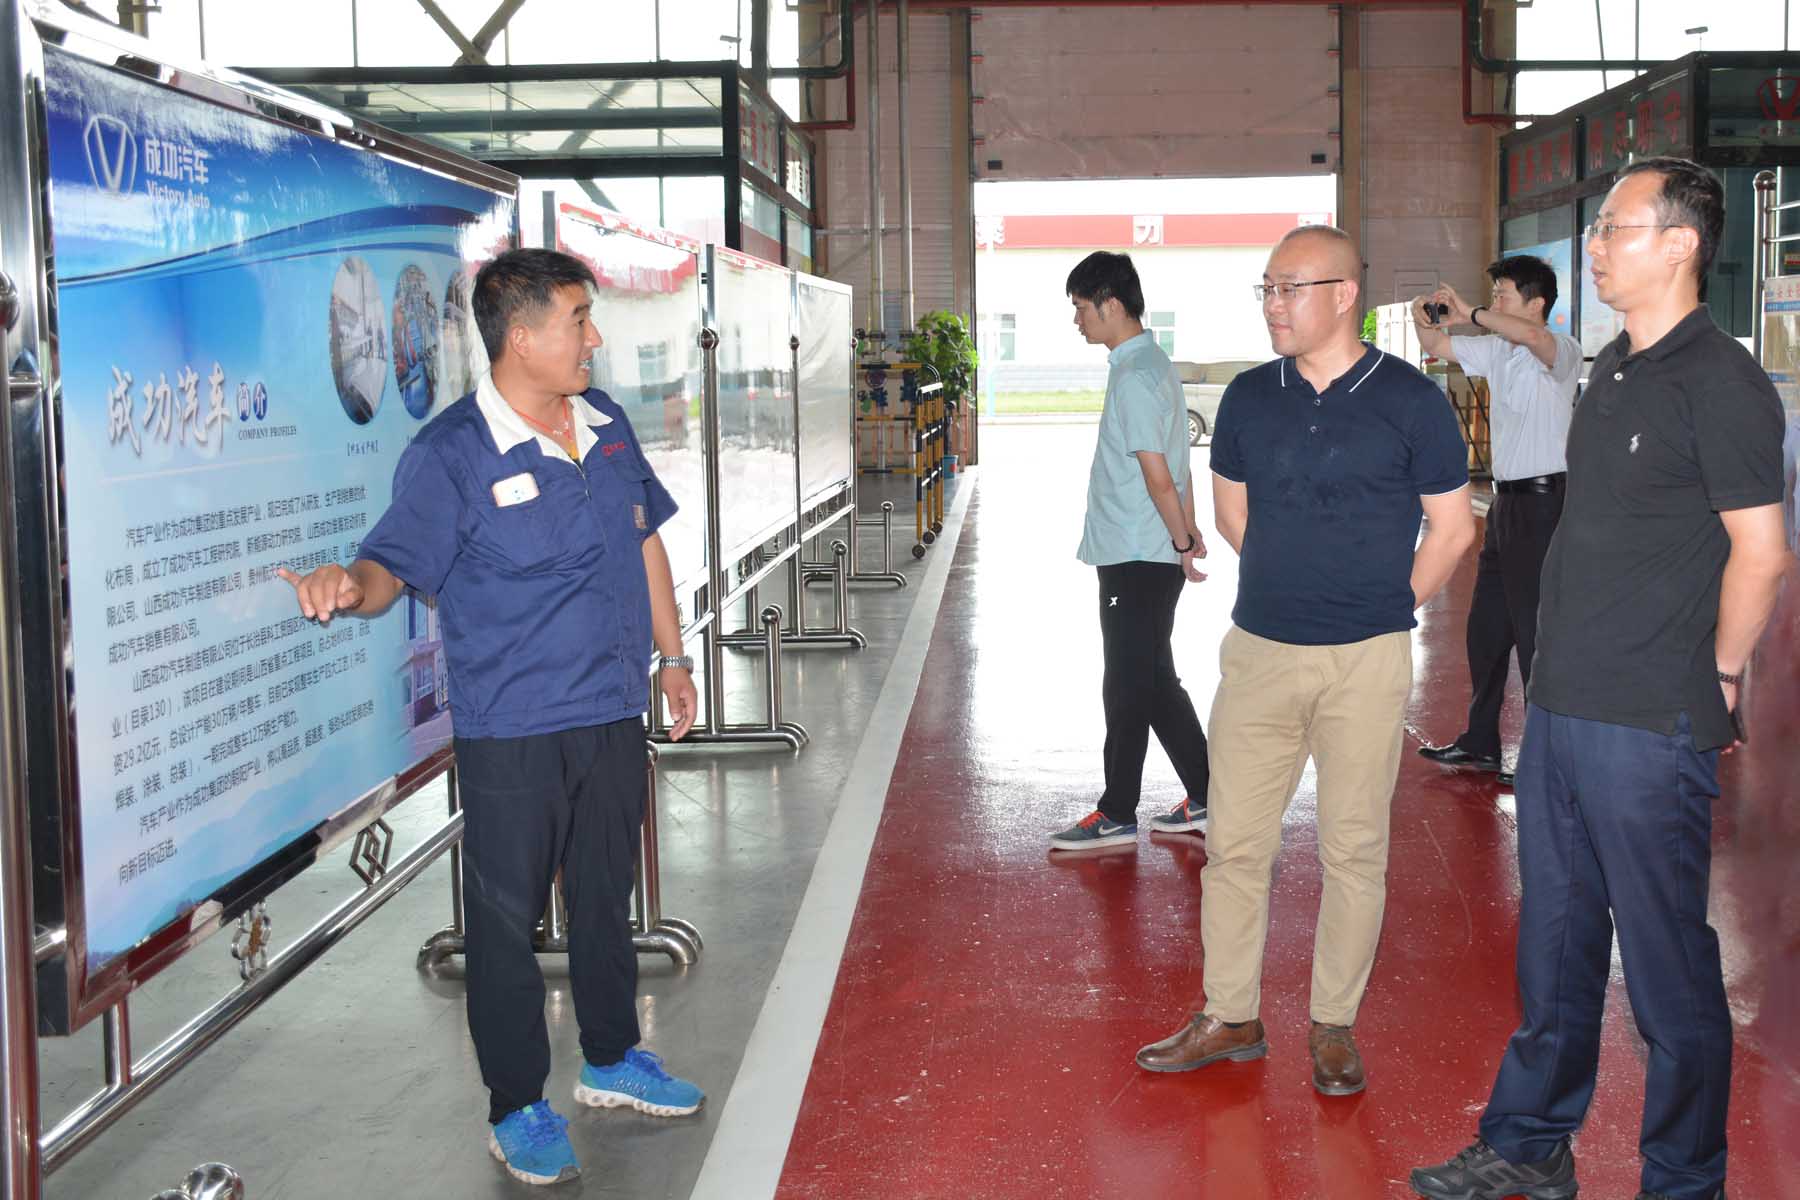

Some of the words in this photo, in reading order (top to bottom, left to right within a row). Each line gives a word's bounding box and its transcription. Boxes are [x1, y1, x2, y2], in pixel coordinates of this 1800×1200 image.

[145, 138, 208, 185] 成功汽车
[146, 180, 185, 208] Victory
[188, 189, 210, 208] Auto
[108, 361, 231, 456] 成功汽车
[237, 382, 267, 421] 简介
[238, 427, 269, 441] COMPANY
[270, 425, 297, 438] PROFILES
[119, 838, 178, 886] 向新目标迈进。
